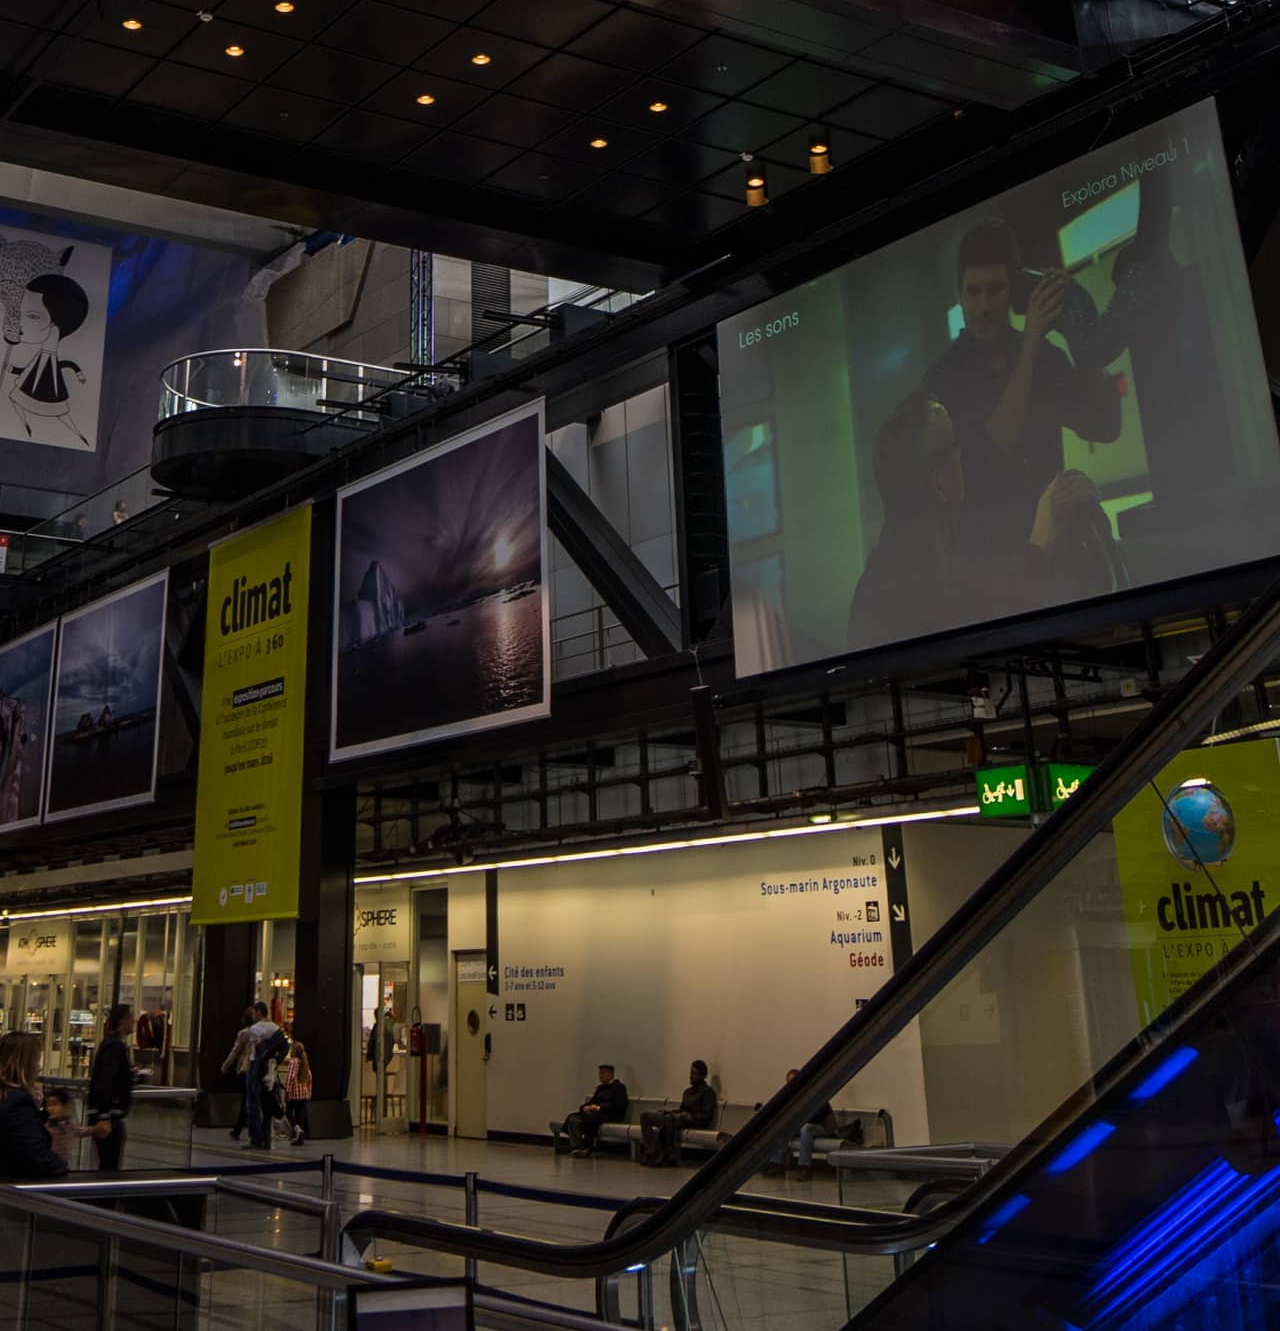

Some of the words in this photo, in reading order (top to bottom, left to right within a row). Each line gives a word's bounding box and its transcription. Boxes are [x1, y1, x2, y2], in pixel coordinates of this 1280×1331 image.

[1061, 174, 1118, 208] Explora
[1120, 147, 1177, 180] Niveau
[1182, 137, 1190, 156] 1
[739, 328, 761, 350] Les
[766, 311, 799, 337] sons
[221, 562, 291, 636] climat
[853, 856, 868, 867] Niv.
[870, 854, 876, 865] 0
[760, 879, 819, 895] Sous-marin
[822, 875, 878, 895] Argonaute
[1157, 880, 1265, 931] climat
[362, 909, 396, 927] SPHERE
[837, 911, 852, 922] Niv.
[854, 909, 862, 921] -2
[830, 930, 883, 949] Aquarium
[1163, 941, 1215, 958] L'EXPO
[849, 952, 884, 967] Géode
[504, 965, 519, 978] Cité
[521, 965, 534, 977] des
[536, 965, 564, 977] enfants
